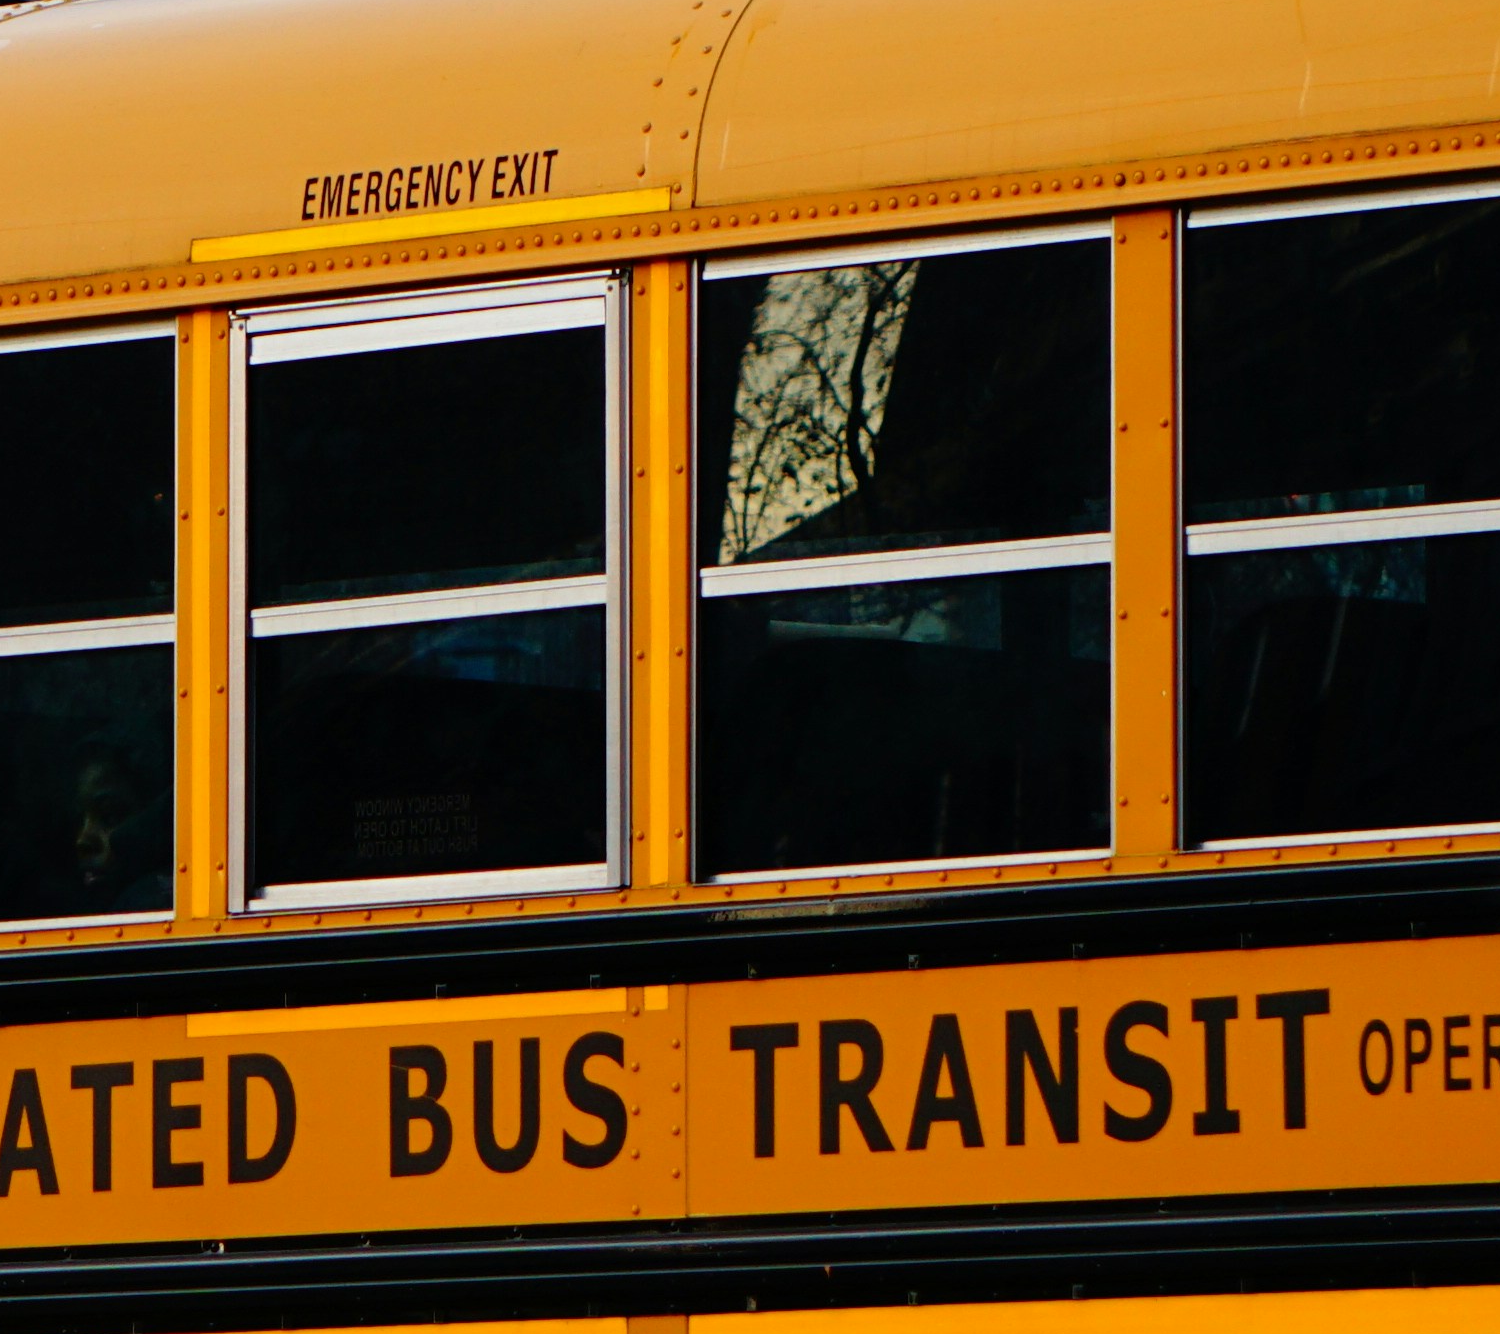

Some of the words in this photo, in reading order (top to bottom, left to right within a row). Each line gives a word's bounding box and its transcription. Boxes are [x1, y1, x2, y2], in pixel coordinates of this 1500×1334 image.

[301, 159, 486, 222] EMERGENCY
[491, 149, 560, 200] EXIT
[388, 1031, 629, 1178] BUS
[730, 988, 1331, 1159] TRANSIT
